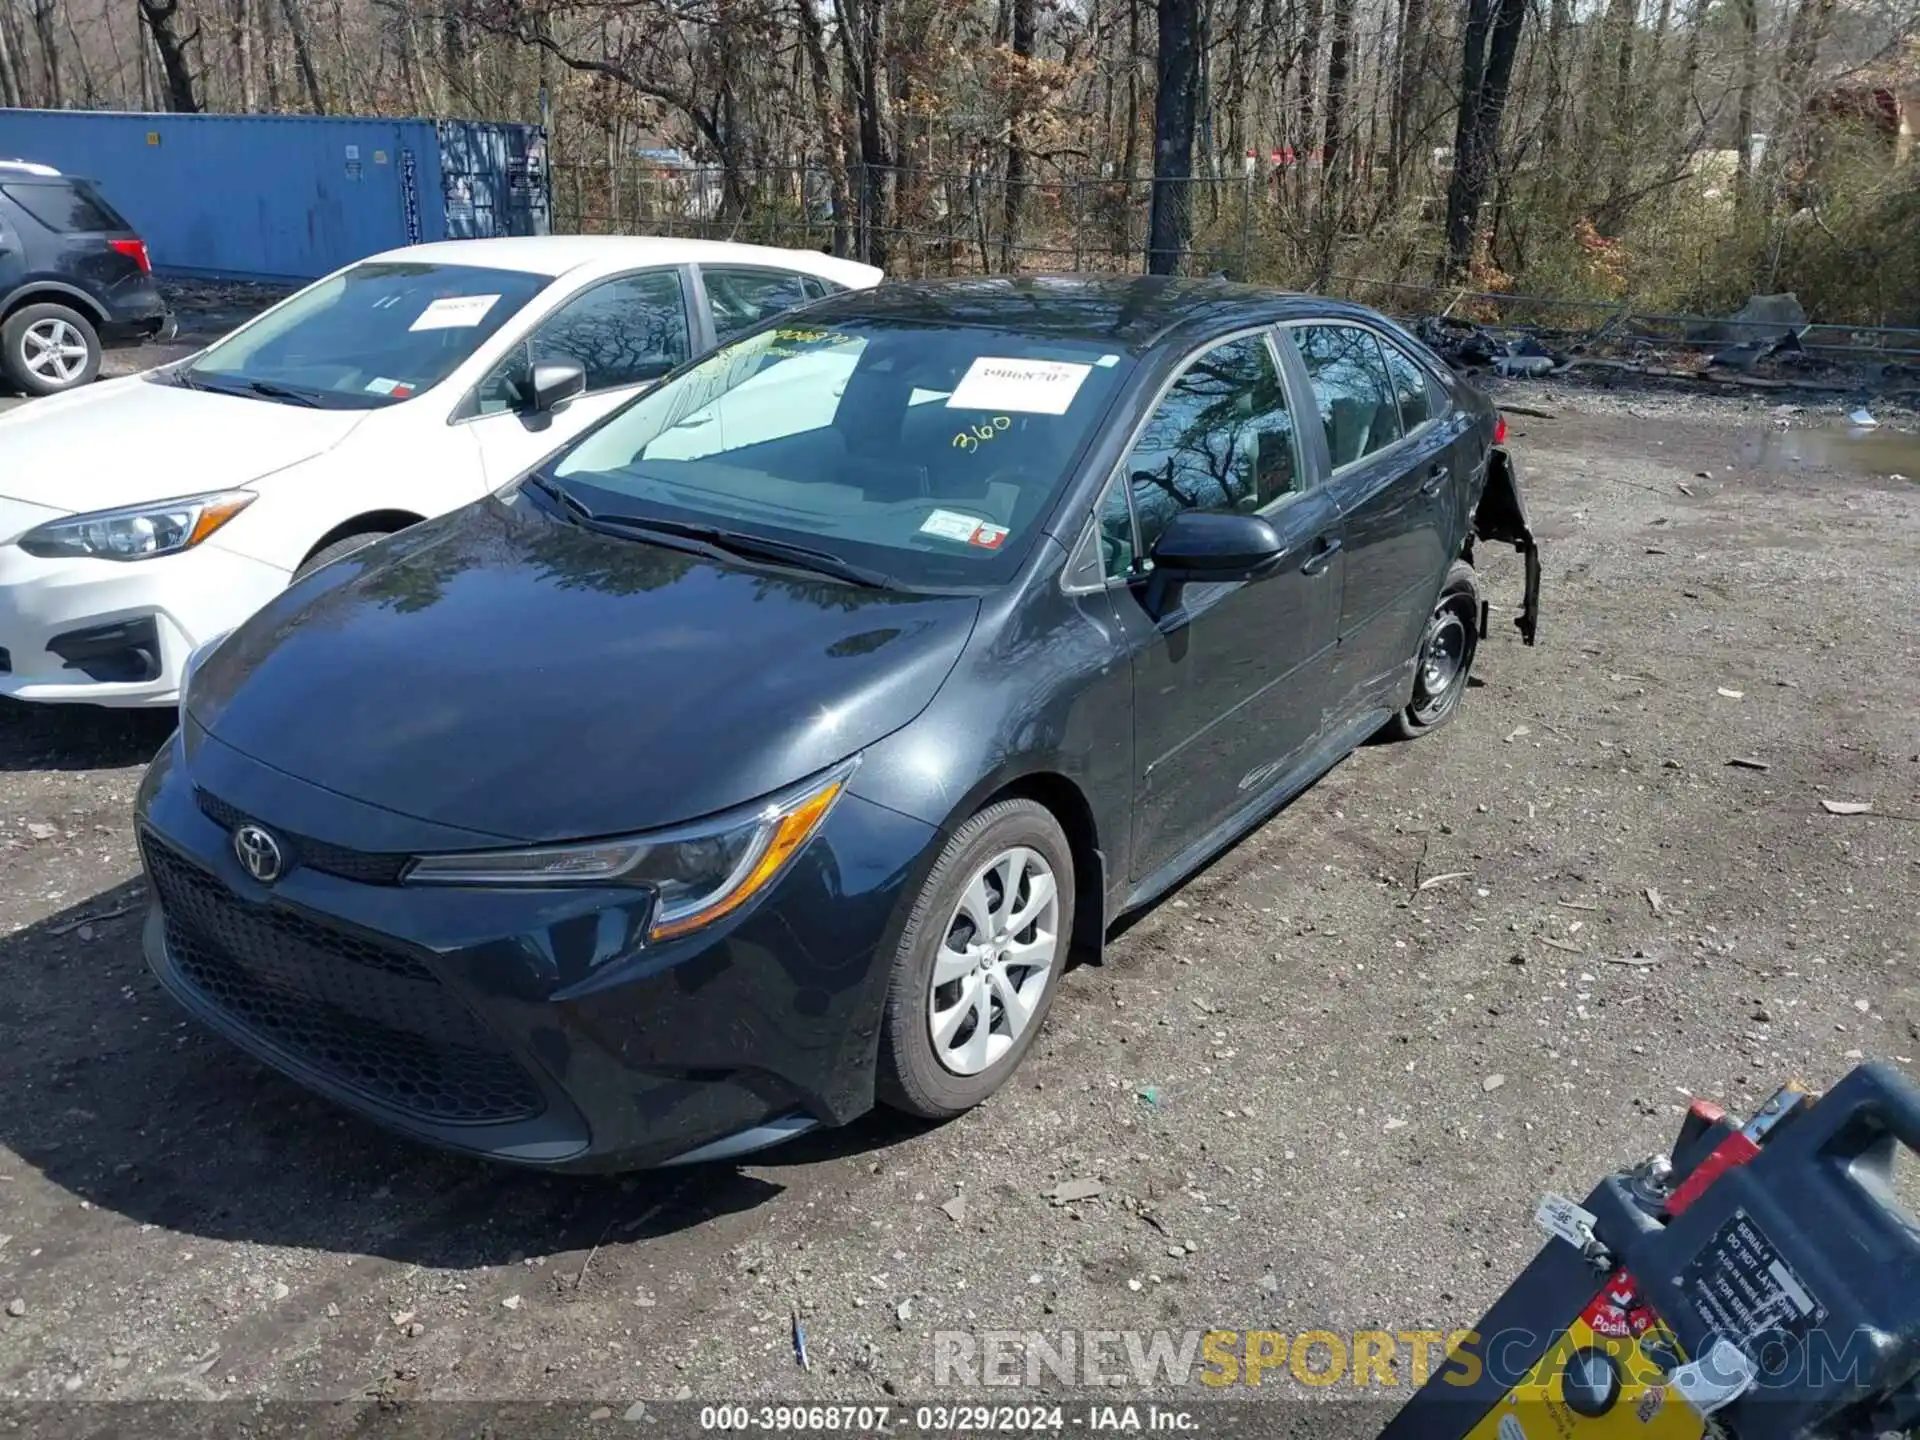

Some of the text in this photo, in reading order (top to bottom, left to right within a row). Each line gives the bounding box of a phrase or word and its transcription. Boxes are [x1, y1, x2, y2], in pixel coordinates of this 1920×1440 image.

[952, 416, 1011, 454] 360
[1737, 1223, 1765, 1254] SERIAL
[1726, 1234, 1740, 1248] DO
[1739, 1249, 1757, 1269] NOT
[1755, 1270, 1773, 1289] LAY
[1716, 1278, 1734, 1298] FOR
[1730, 1296, 1760, 1331] SERVIC
